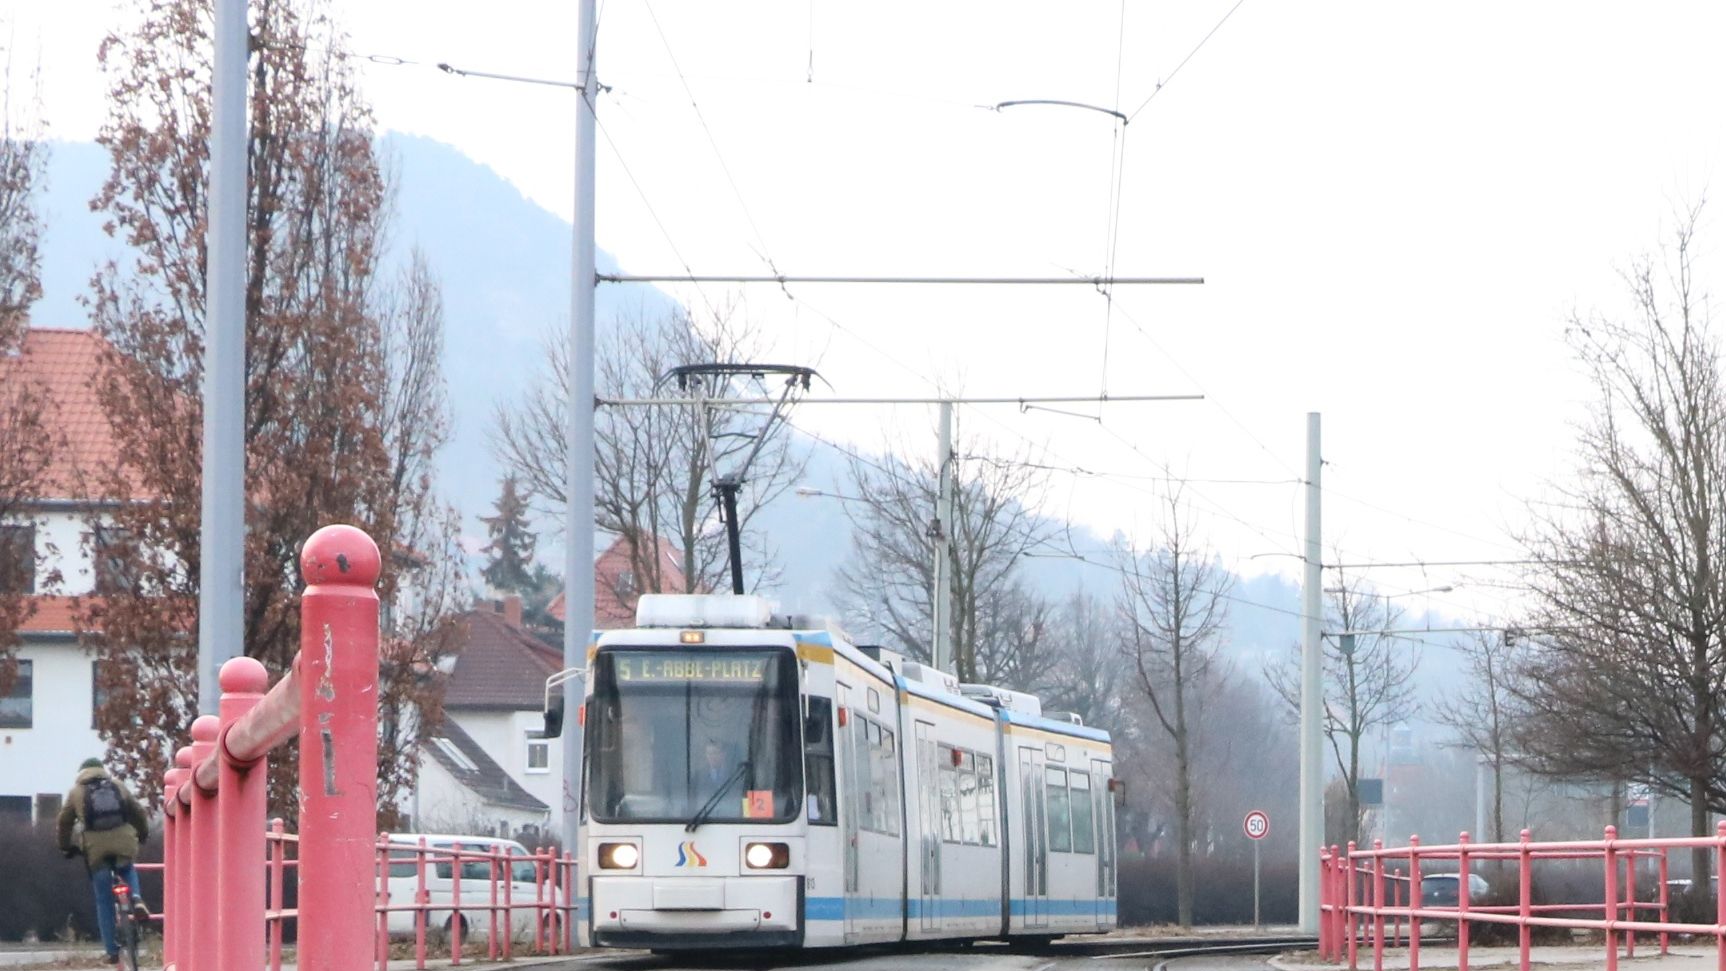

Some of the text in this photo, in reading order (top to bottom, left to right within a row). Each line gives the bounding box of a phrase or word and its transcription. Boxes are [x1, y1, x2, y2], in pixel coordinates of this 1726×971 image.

[619, 661, 631, 680] 5
[757, 798, 767, 811] 2
[1250, 819, 1264, 832] 50
